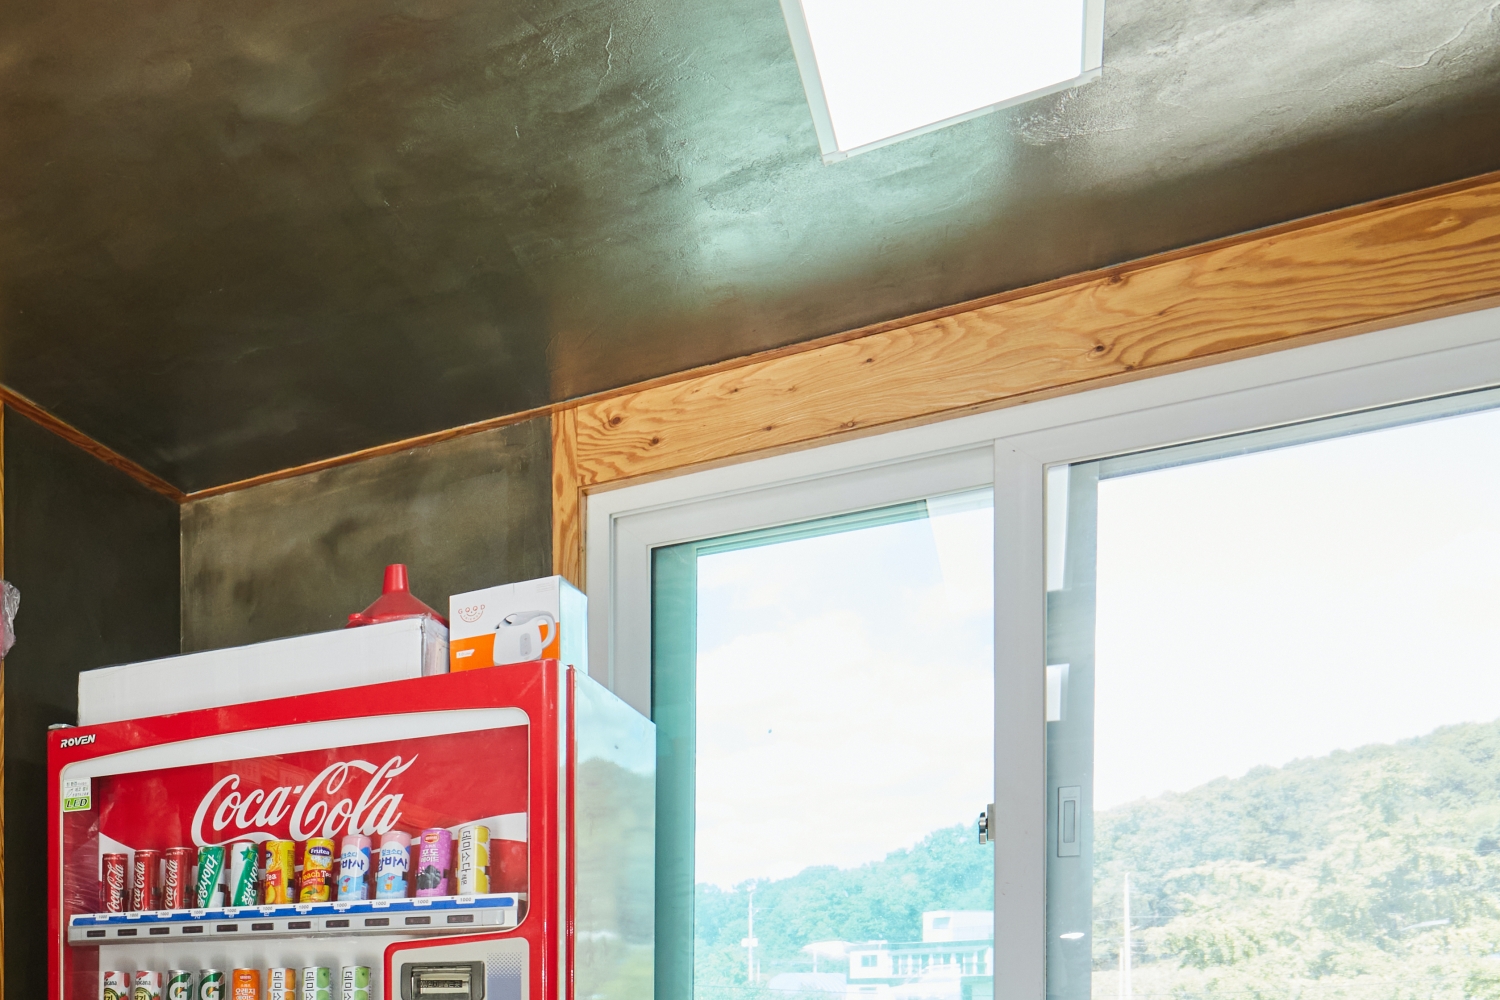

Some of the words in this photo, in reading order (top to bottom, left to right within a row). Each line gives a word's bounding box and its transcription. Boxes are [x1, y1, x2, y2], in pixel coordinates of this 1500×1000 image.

[60, 734, 96, 748] ROVEN
[190, 753, 419, 846] Coca-Cola
[310, 848, 330, 856] Frutea
[422, 848, 438, 857] 포도
[462, 830, 471, 872] 데미소다
[341, 857, 364, 870] 바사
[378, 857, 408, 870] 암바사
